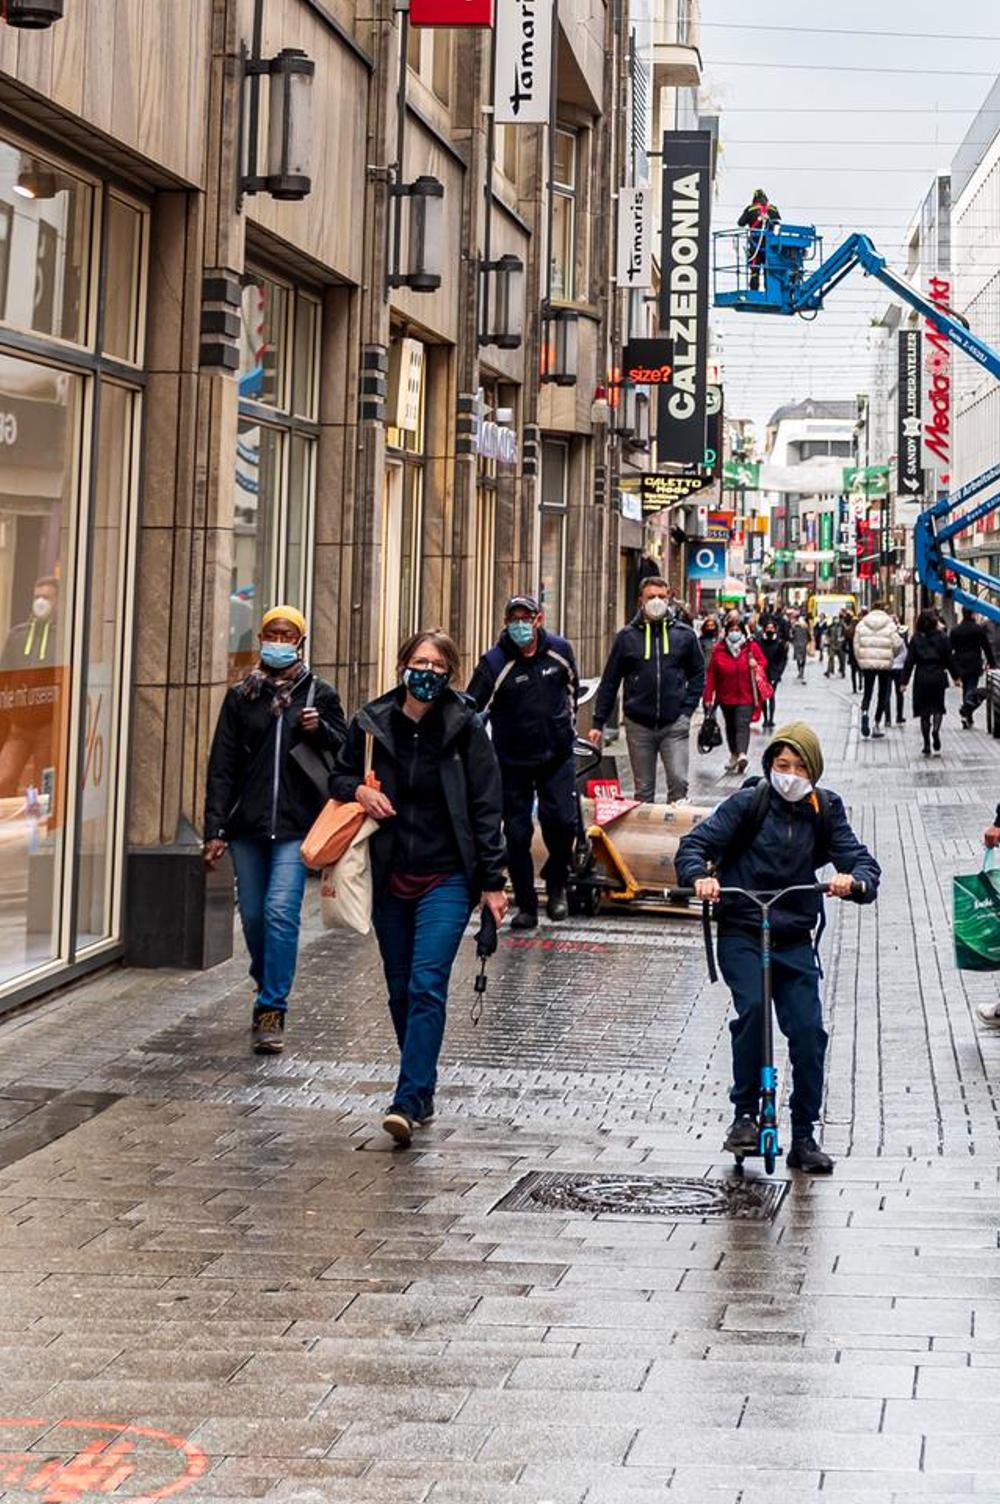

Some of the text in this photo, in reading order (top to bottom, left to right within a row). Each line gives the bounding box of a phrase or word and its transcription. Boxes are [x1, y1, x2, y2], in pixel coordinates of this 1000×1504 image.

[668, 172, 701, 420] CALZEDONIA
[629, 365, 672, 383] size?
[906, 437, 918, 475] SANDY
